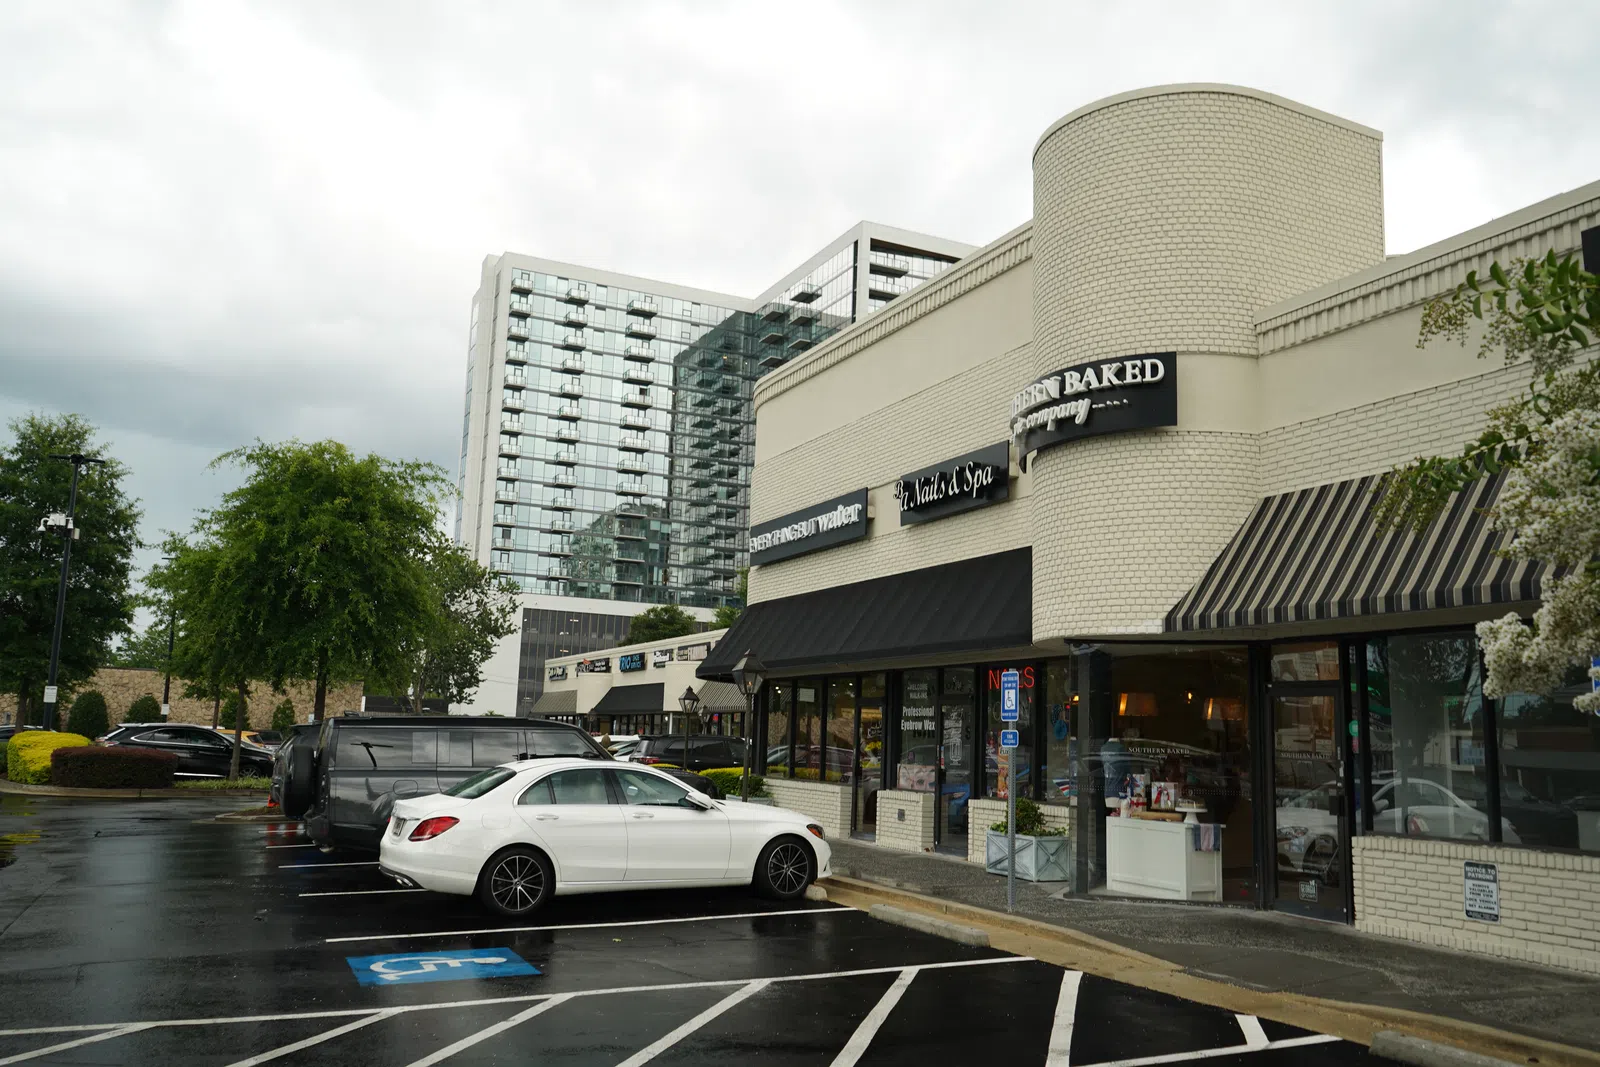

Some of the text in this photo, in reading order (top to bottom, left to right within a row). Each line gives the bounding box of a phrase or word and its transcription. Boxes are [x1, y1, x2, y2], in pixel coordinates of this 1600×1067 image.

[1063, 358, 1165, 396] BAKED
[1026, 398, 1092, 432] company
[910, 471, 946, 508] Nails
[963, 460, 994, 499] Spa
[749, 524, 798, 554] EVERYTHING
[817, 503, 862, 533] water
[900, 719, 936, 731] Eyebrow Wax
[902, 705, 935, 717] Professional
[1467, 872, 1494, 880] PATRONS
